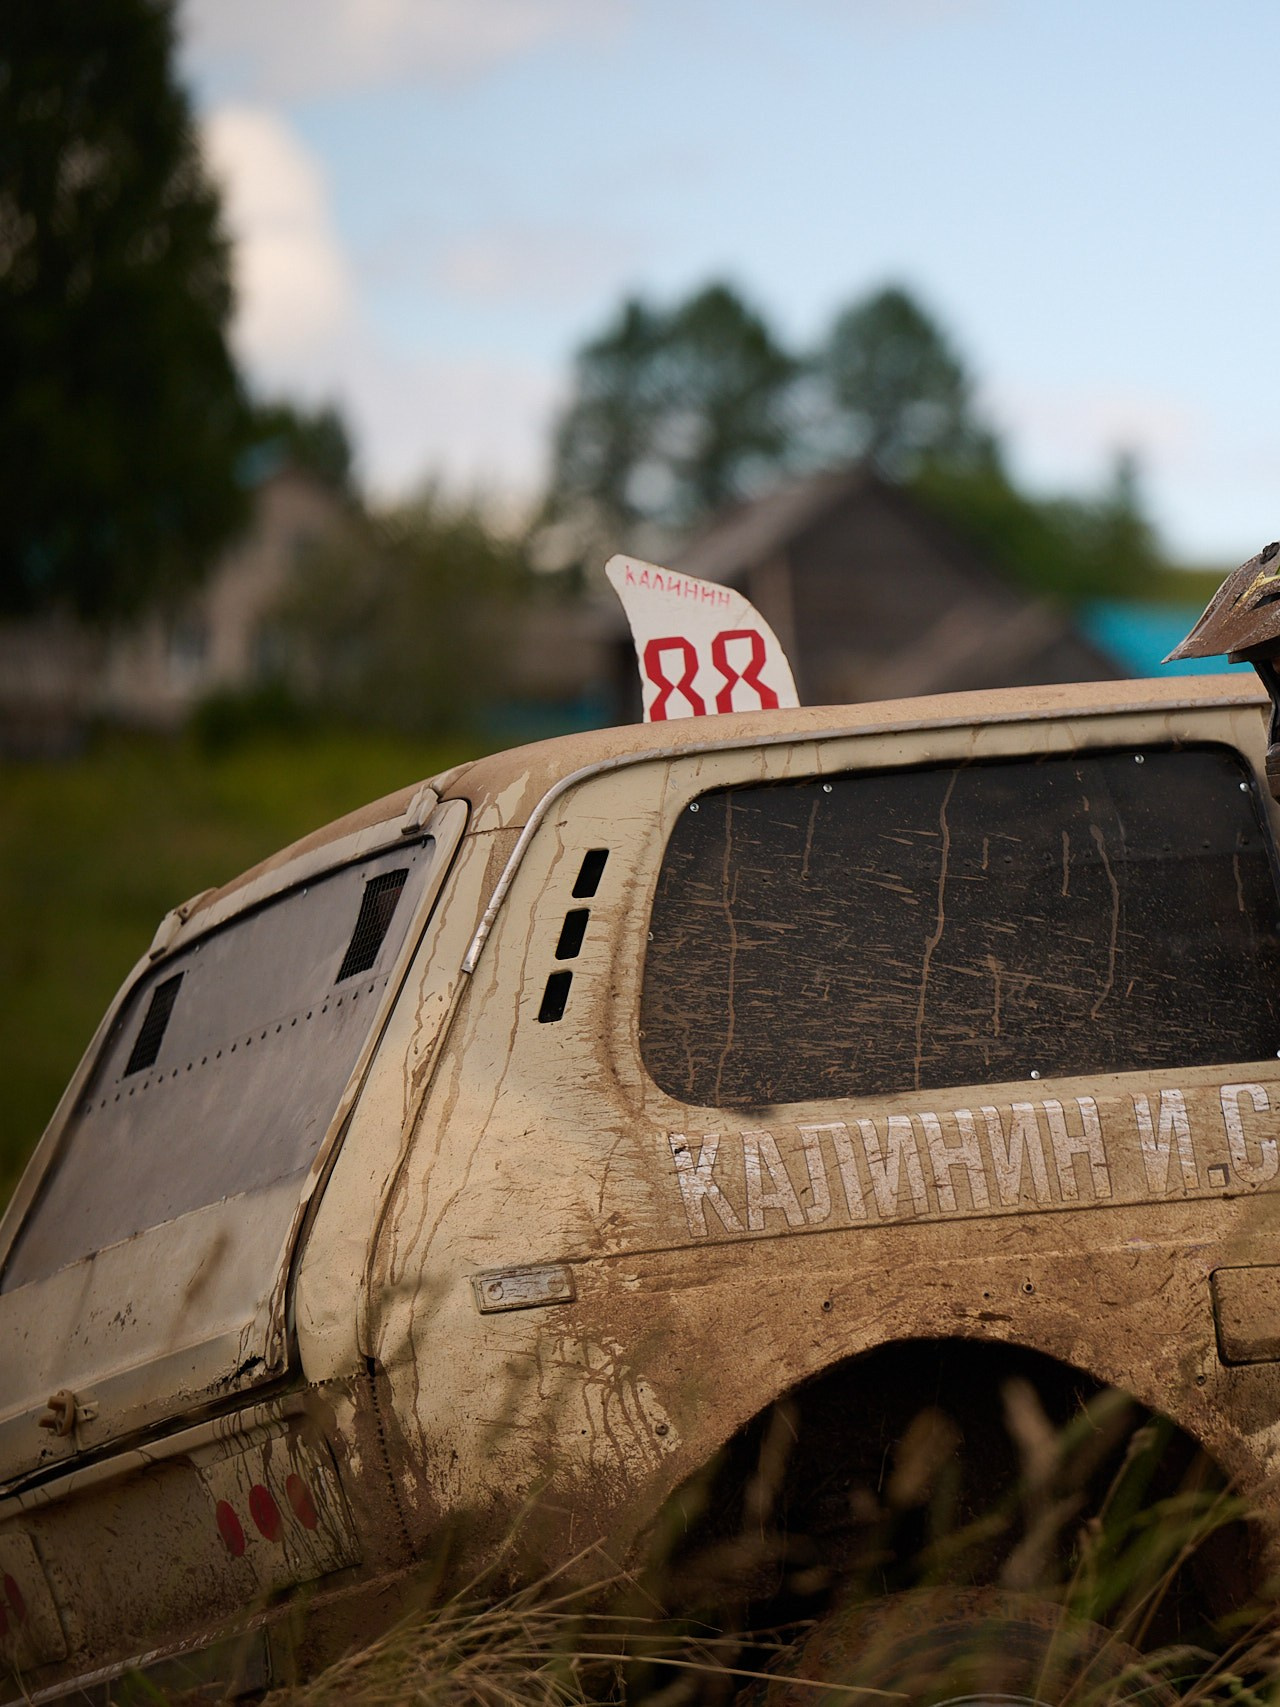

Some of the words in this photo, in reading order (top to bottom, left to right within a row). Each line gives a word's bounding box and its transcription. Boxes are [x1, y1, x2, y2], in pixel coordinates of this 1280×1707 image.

[625, 565, 731, 608] КАЛИНИН
[644, 629, 779, 722] 88
[667, 1096, 1112, 1239] КАЛИНИН
